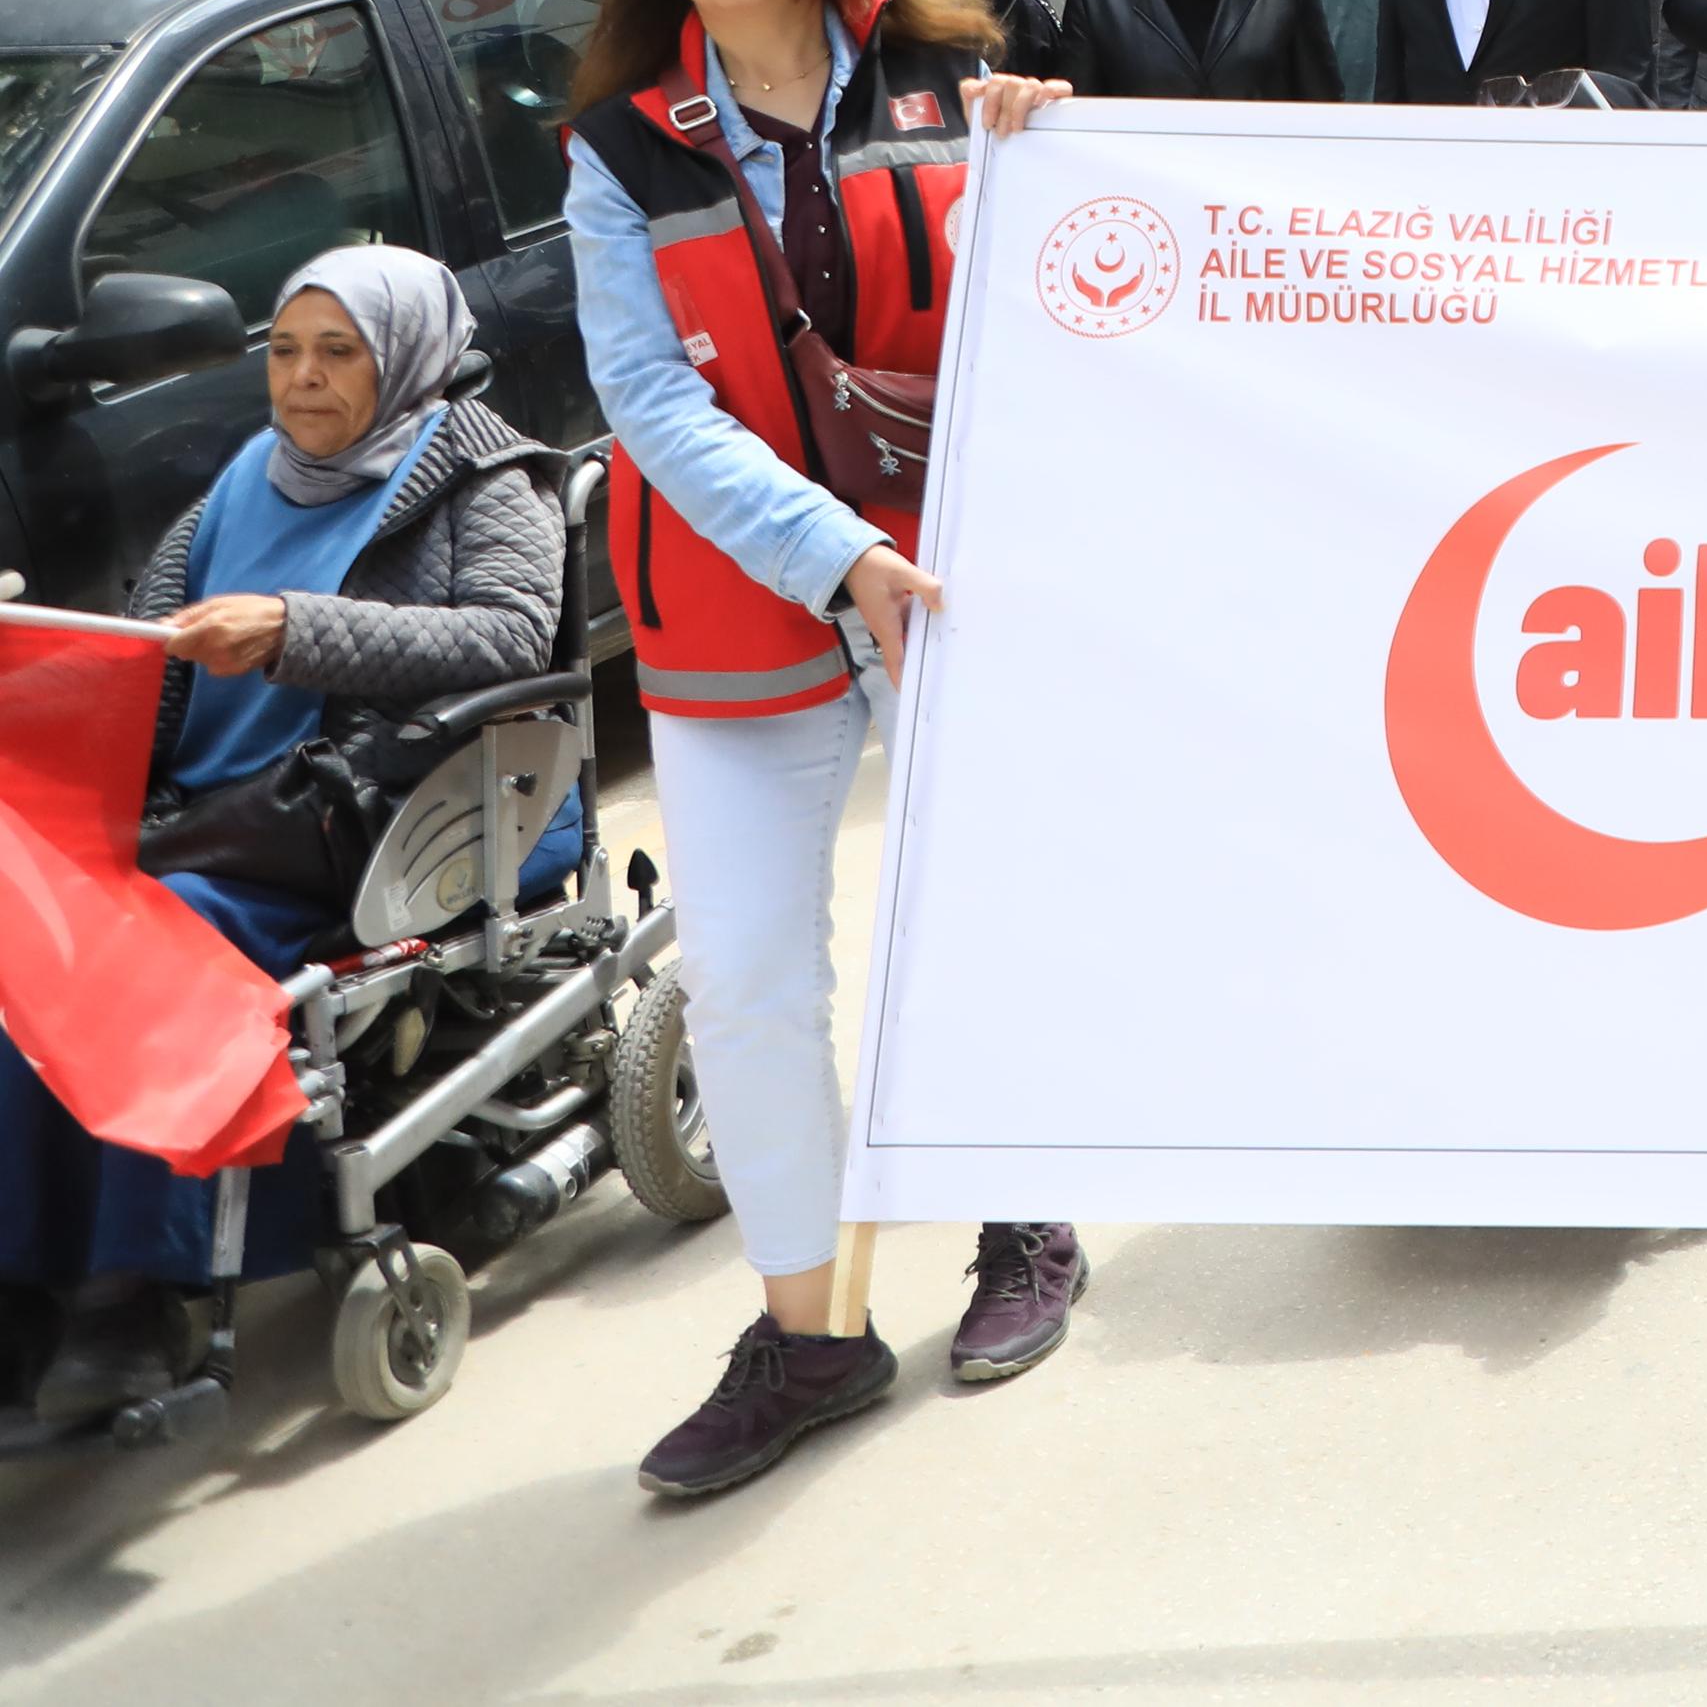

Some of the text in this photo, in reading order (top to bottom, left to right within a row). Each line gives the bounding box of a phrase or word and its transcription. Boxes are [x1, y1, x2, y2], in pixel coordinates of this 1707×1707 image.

[1202, 203, 1615, 247] T.C. ELAZIĞ VALİLİĞİ
[1199, 247, 1287, 281] AİLE
[1299, 248, 1349, 281] VE
[1361, 250, 1526, 285] SOSYAL
[1198, 289, 1499, 325] İL MÜDÜRLÜĞÜ
[686, 337, 712, 354] SYAL
